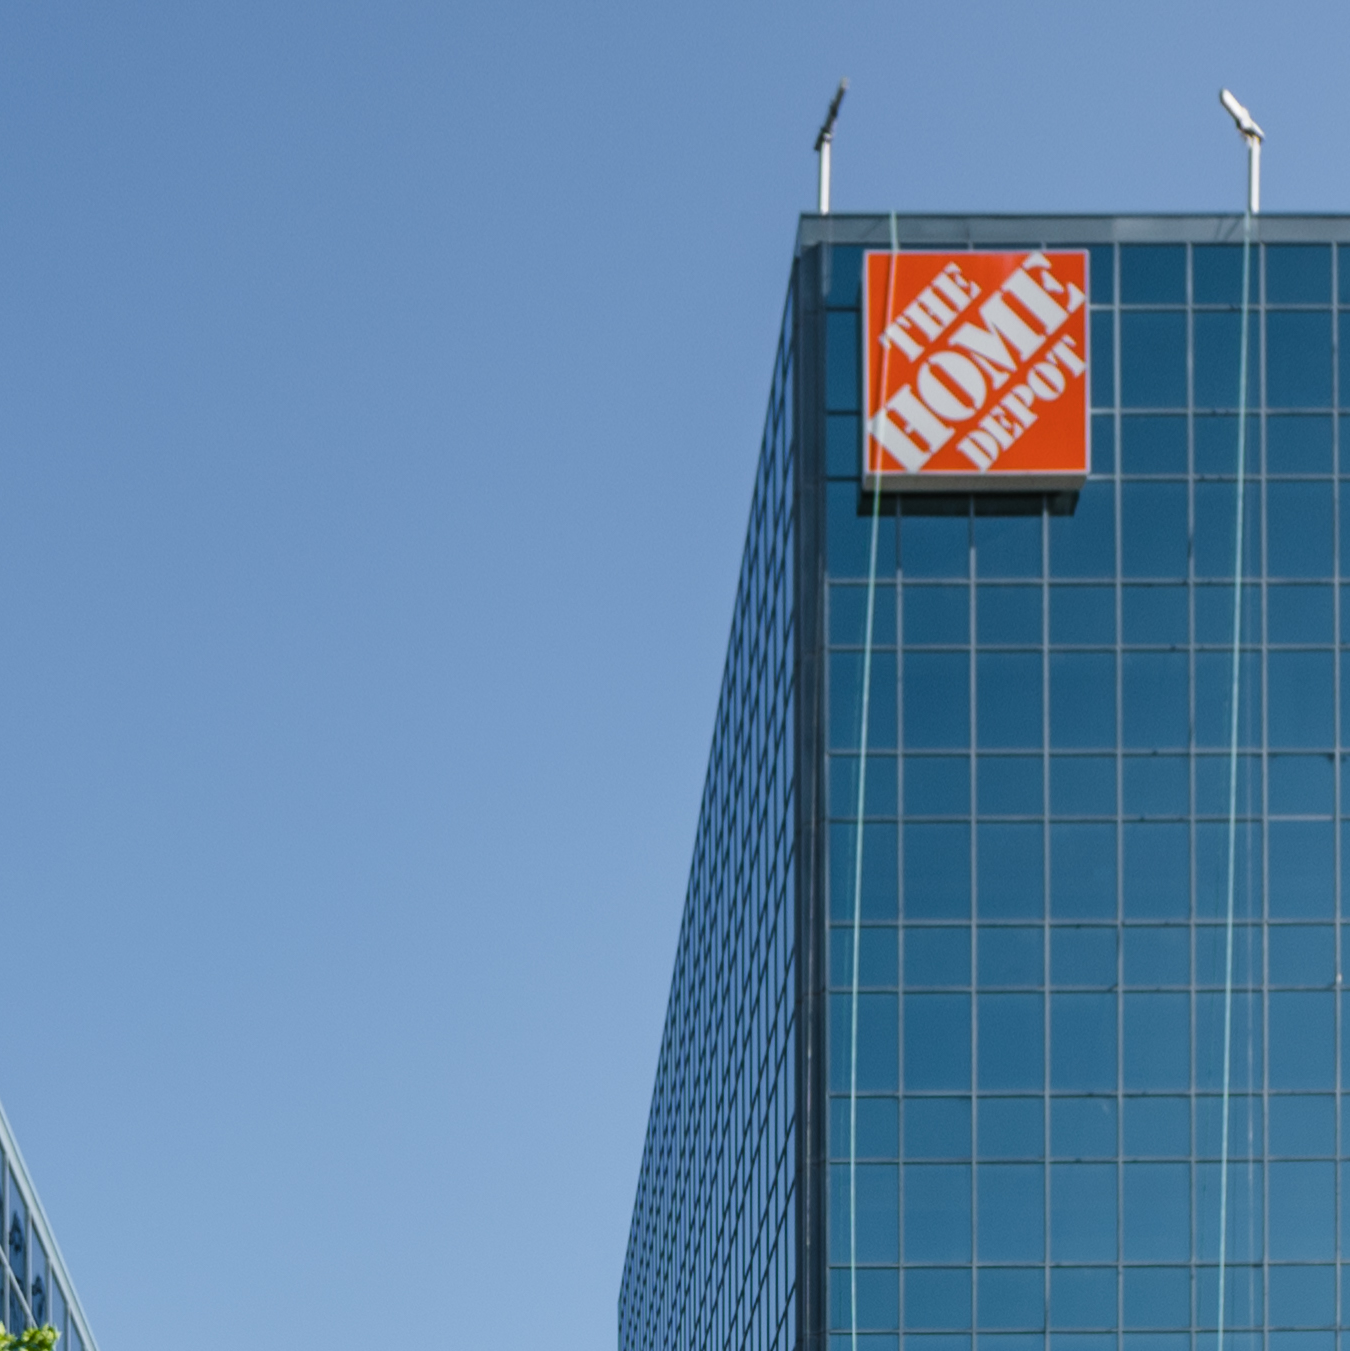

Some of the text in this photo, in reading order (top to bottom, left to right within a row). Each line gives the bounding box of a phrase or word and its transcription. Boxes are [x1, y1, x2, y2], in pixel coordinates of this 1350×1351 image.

[868, 251, 1086, 475] HOME
[878, 261, 982, 363] THE
[956, 334, 1087, 475] DEPOT
